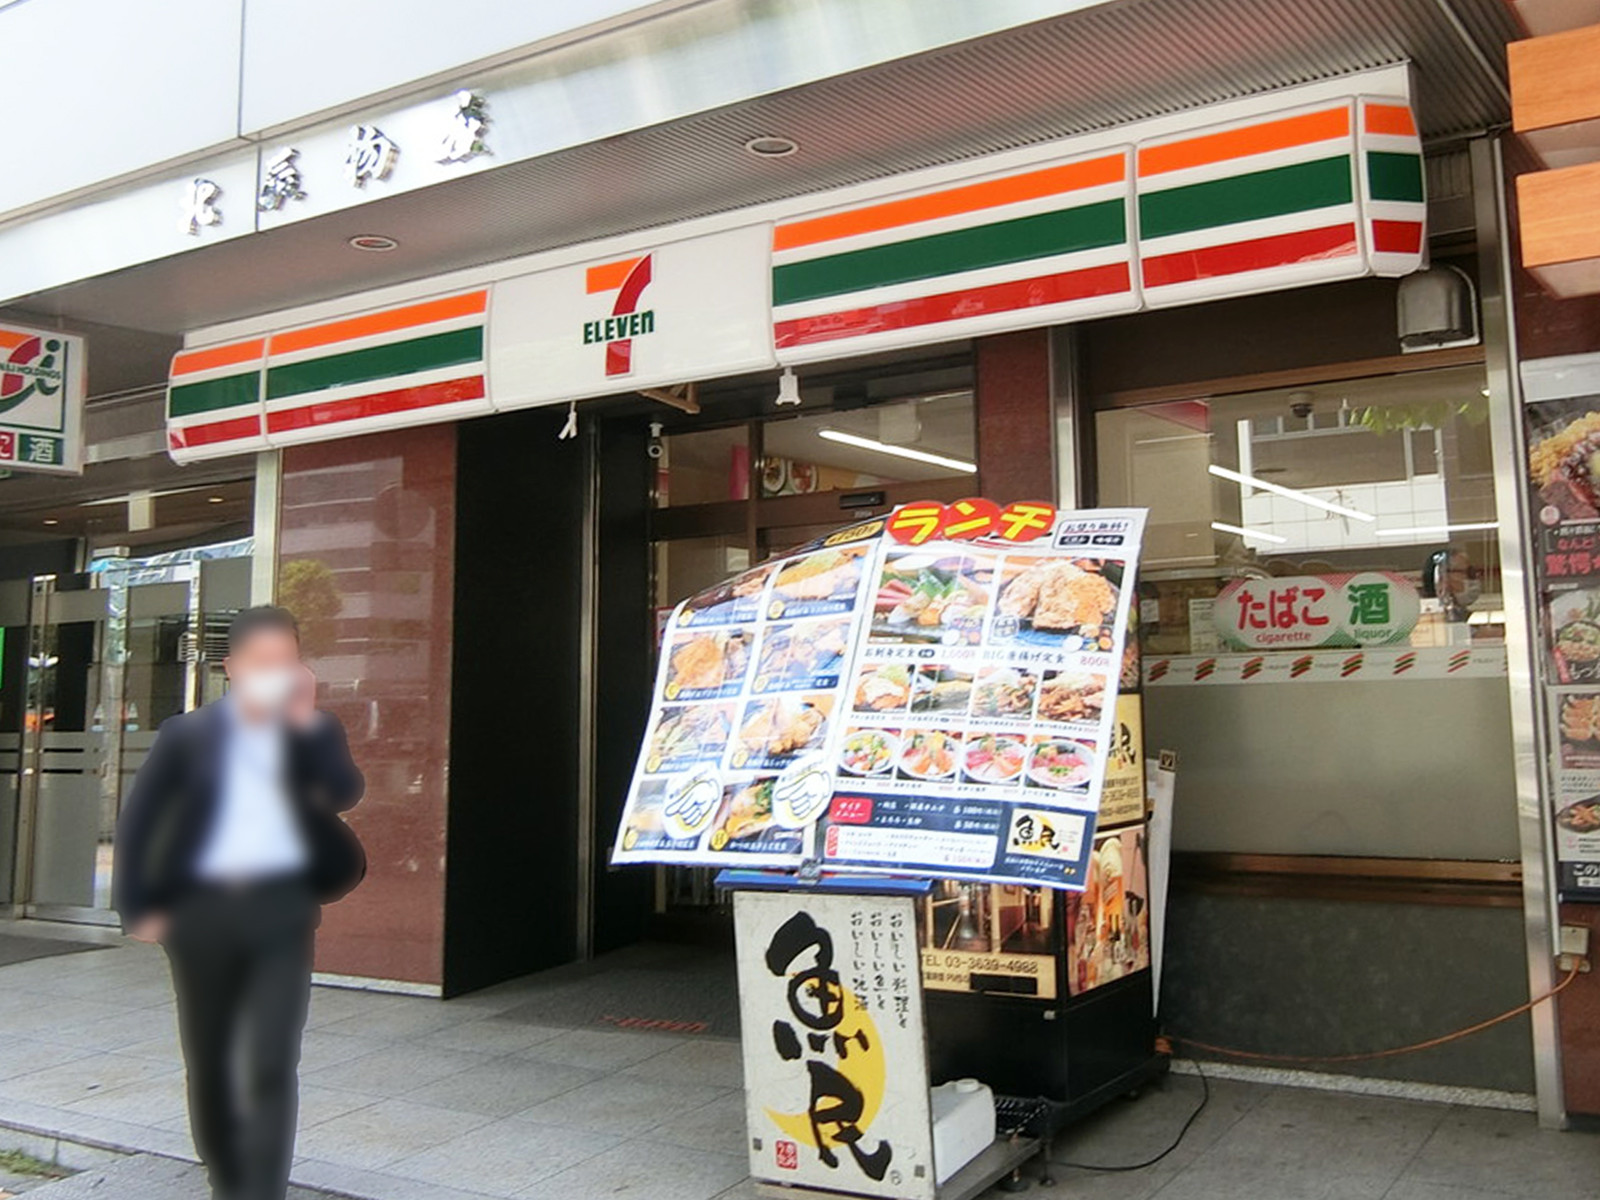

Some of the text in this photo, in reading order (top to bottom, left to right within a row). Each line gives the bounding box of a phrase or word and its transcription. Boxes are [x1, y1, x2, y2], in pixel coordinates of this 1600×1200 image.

[29, 436, 55, 463] 酒
[892, 501, 1053, 545] ランチ
[1237, 583, 1390, 630] たばこ 酒
[1255, 627, 1393, 644] cigarette liquor
[765, 910, 894, 1182] 魚民
